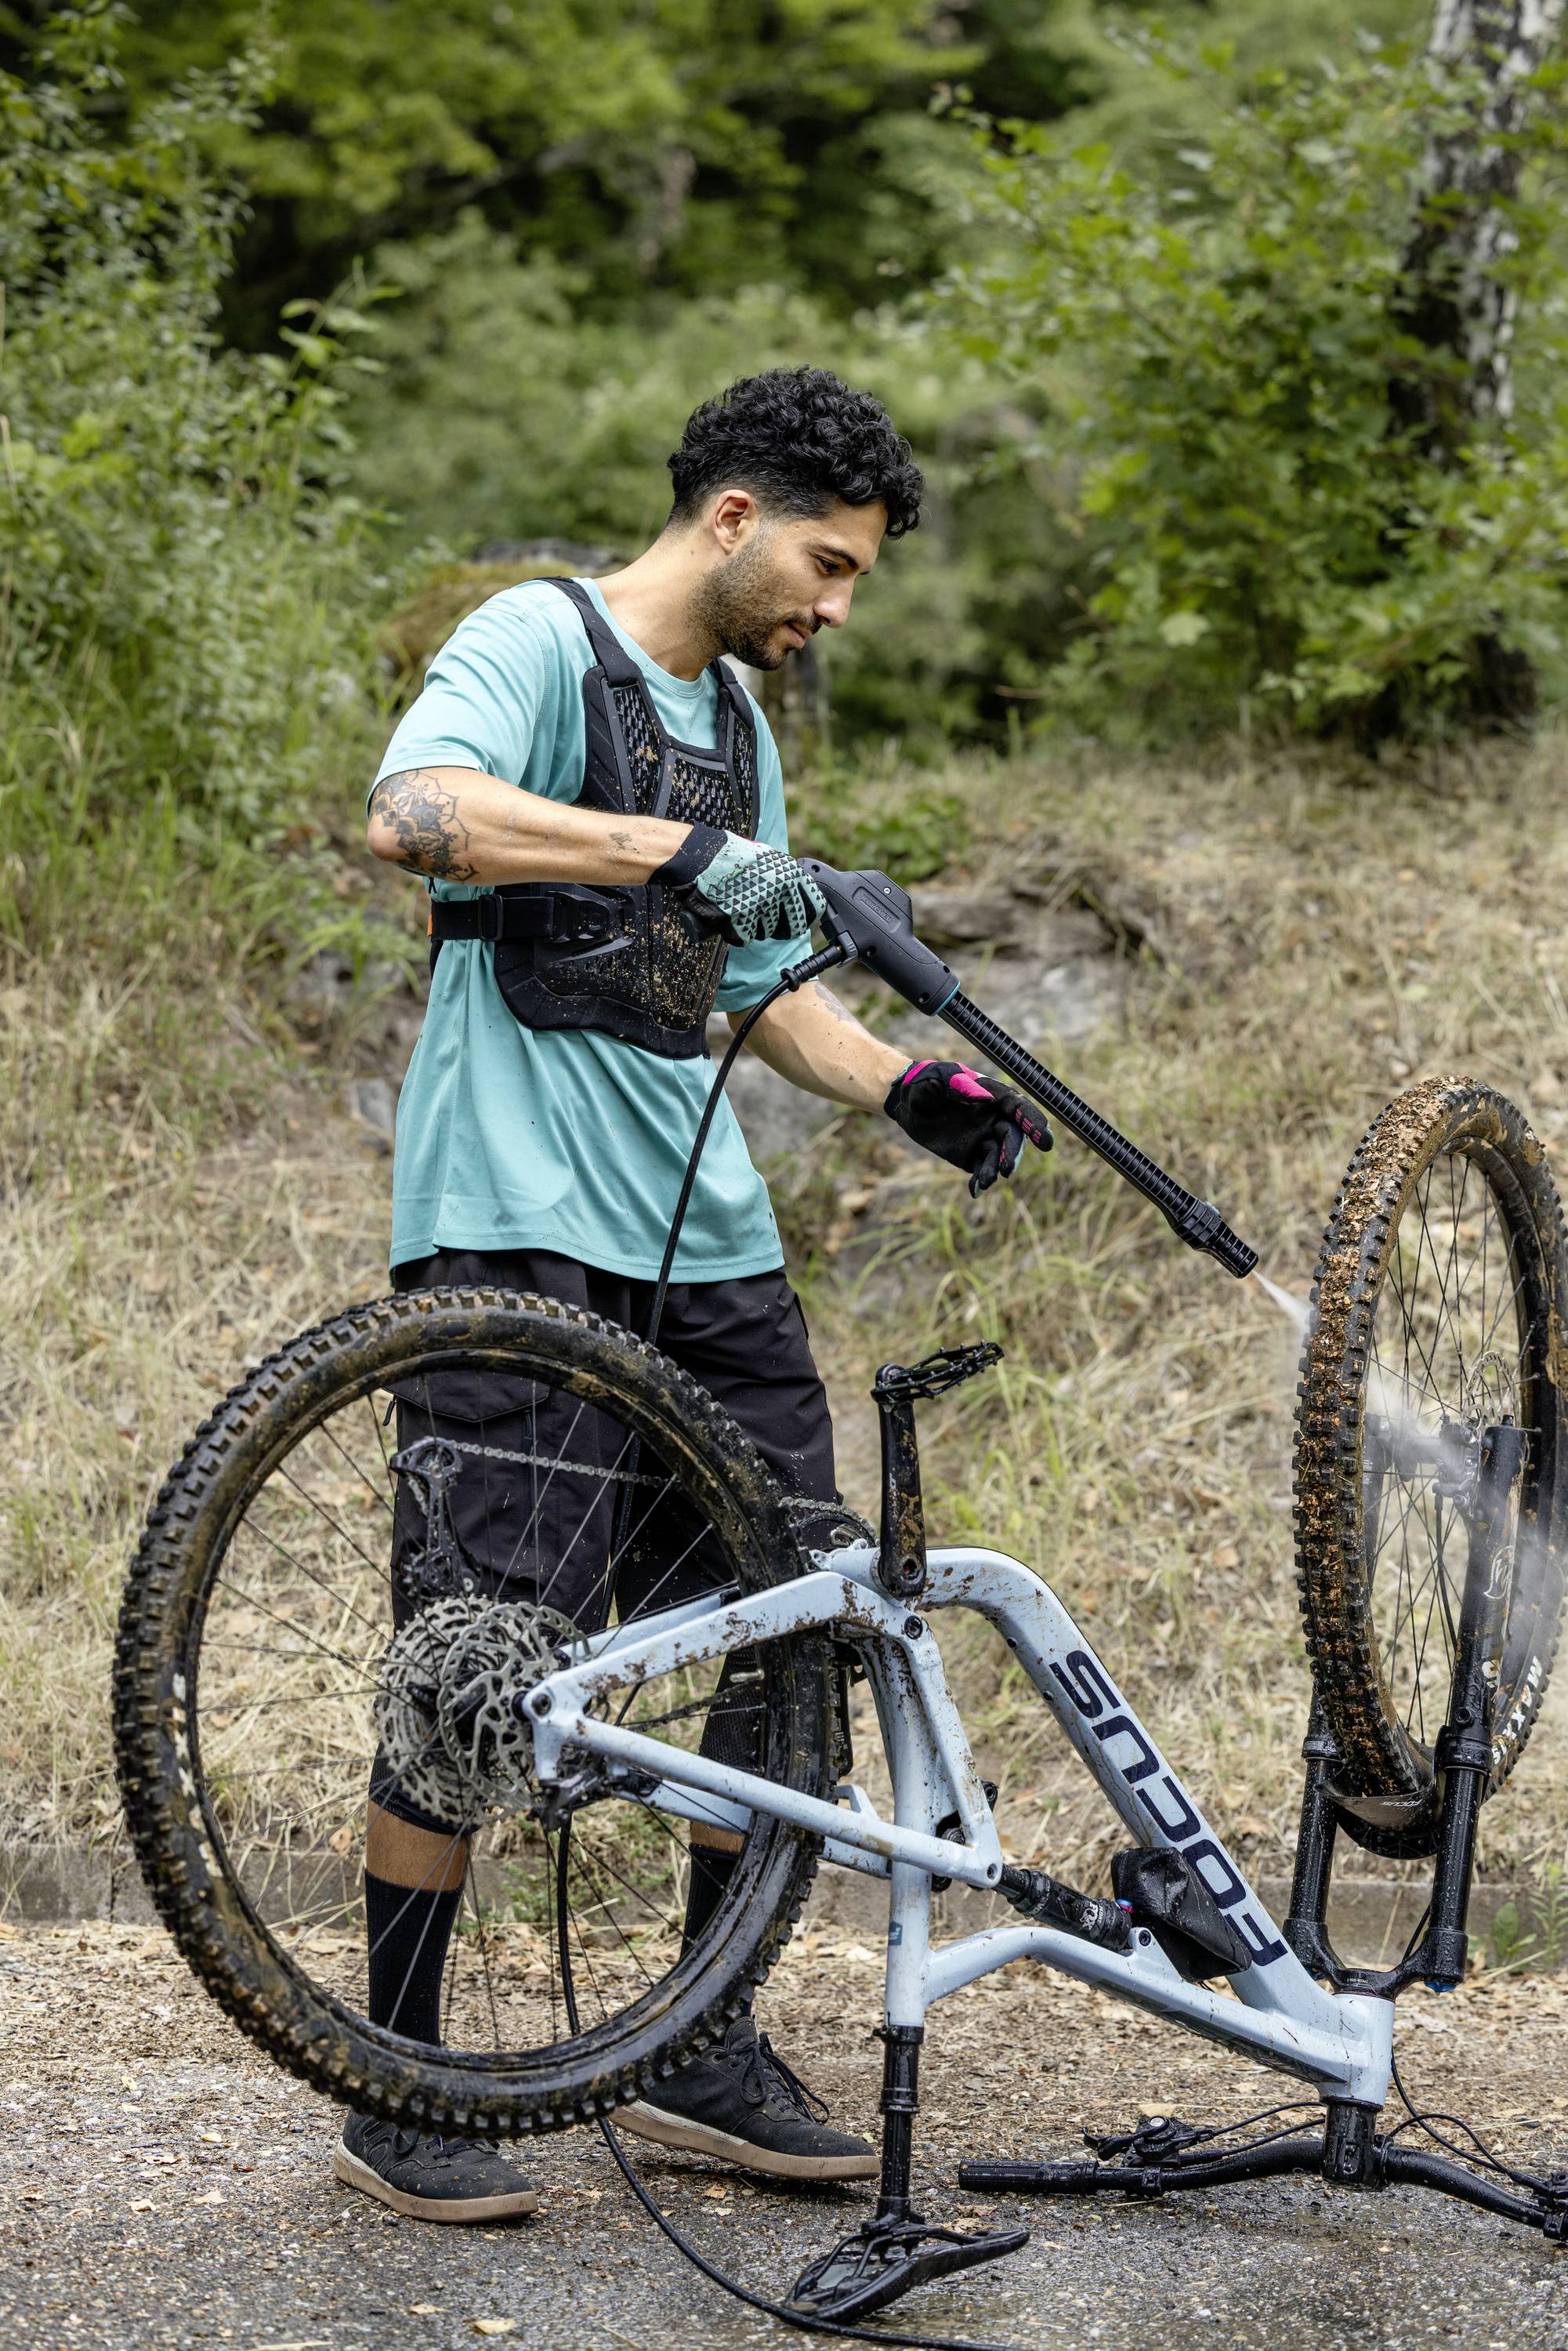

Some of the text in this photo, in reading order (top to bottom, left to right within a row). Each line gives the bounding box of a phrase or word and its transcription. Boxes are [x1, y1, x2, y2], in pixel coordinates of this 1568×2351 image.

[1490, 1655, 1543, 1765] MAXXIS
[1049, 1650, 1288, 1967] FOCUS
[1380, 1799, 1423, 1807] FOCUS
[1079, 1901, 1099, 1930] FOX
